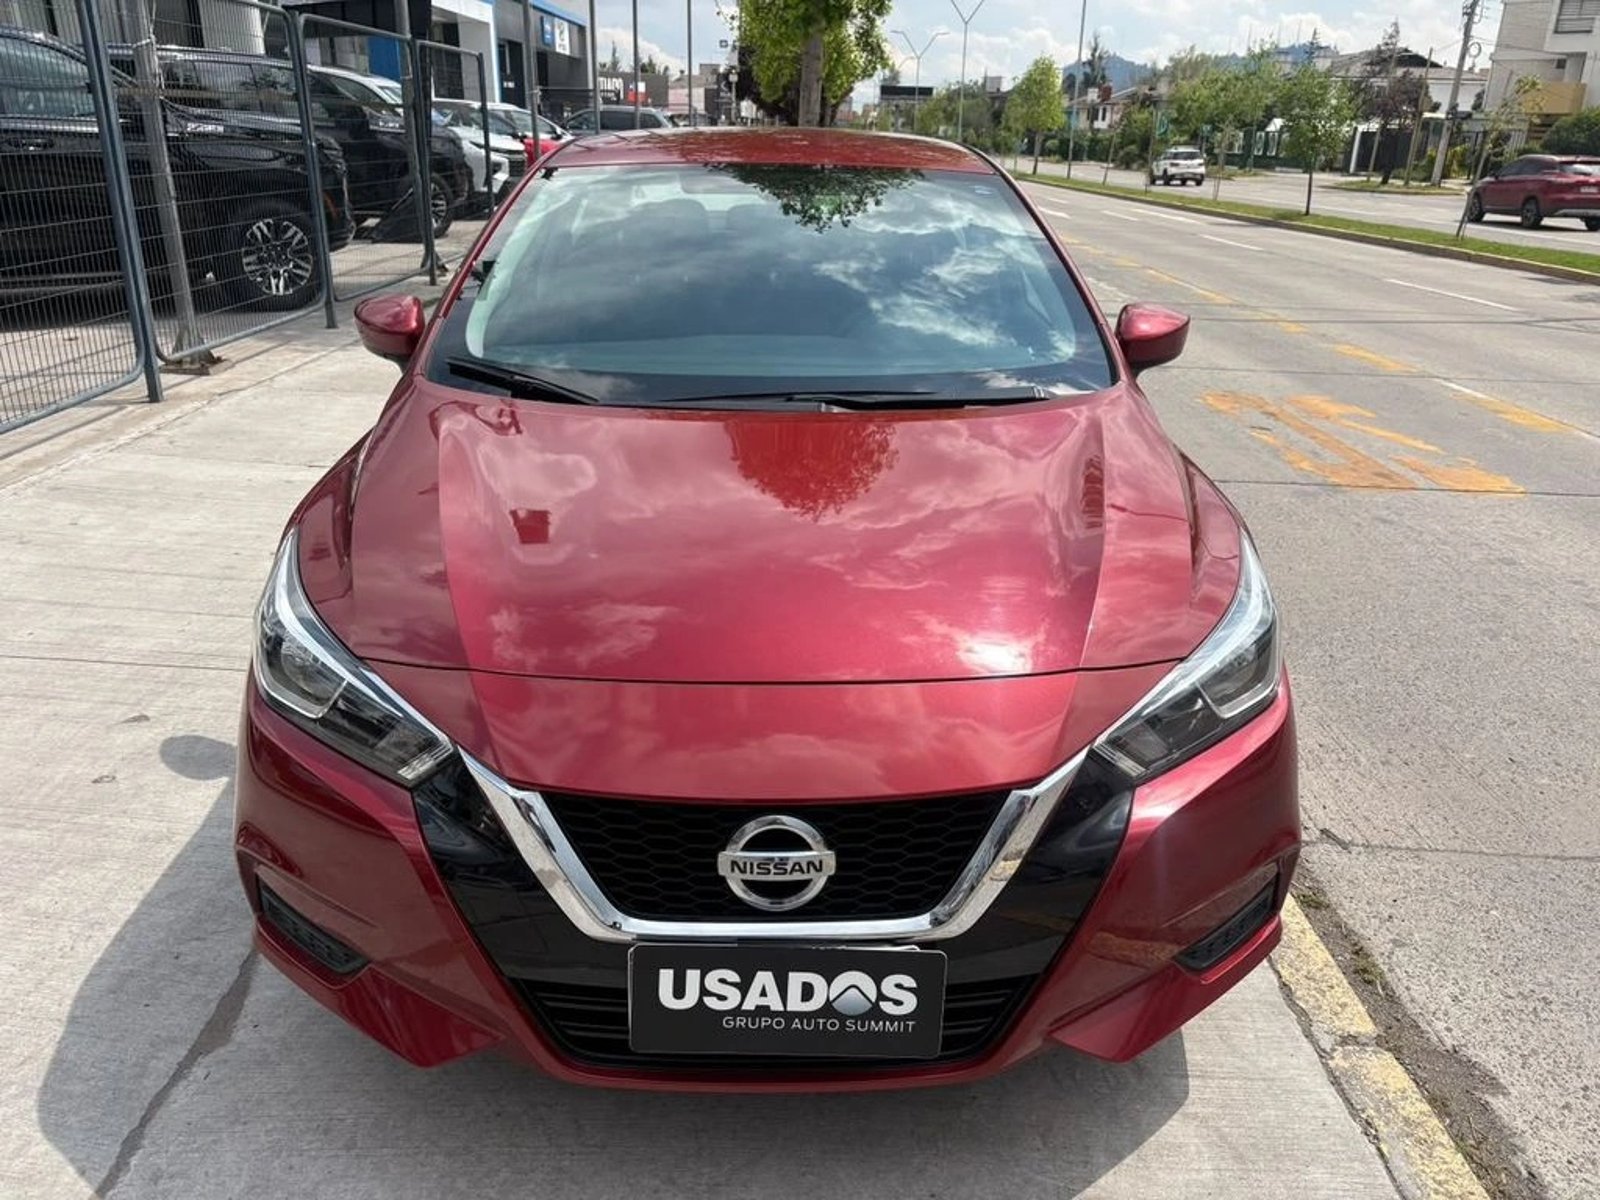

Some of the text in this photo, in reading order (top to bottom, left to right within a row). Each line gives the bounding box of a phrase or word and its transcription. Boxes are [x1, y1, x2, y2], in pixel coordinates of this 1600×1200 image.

[730, 860, 823, 876] NISSAN
[658, 968, 918, 1016] USADOS
[722, 1017, 916, 1033] GRUPO AUTO SUMMIT
